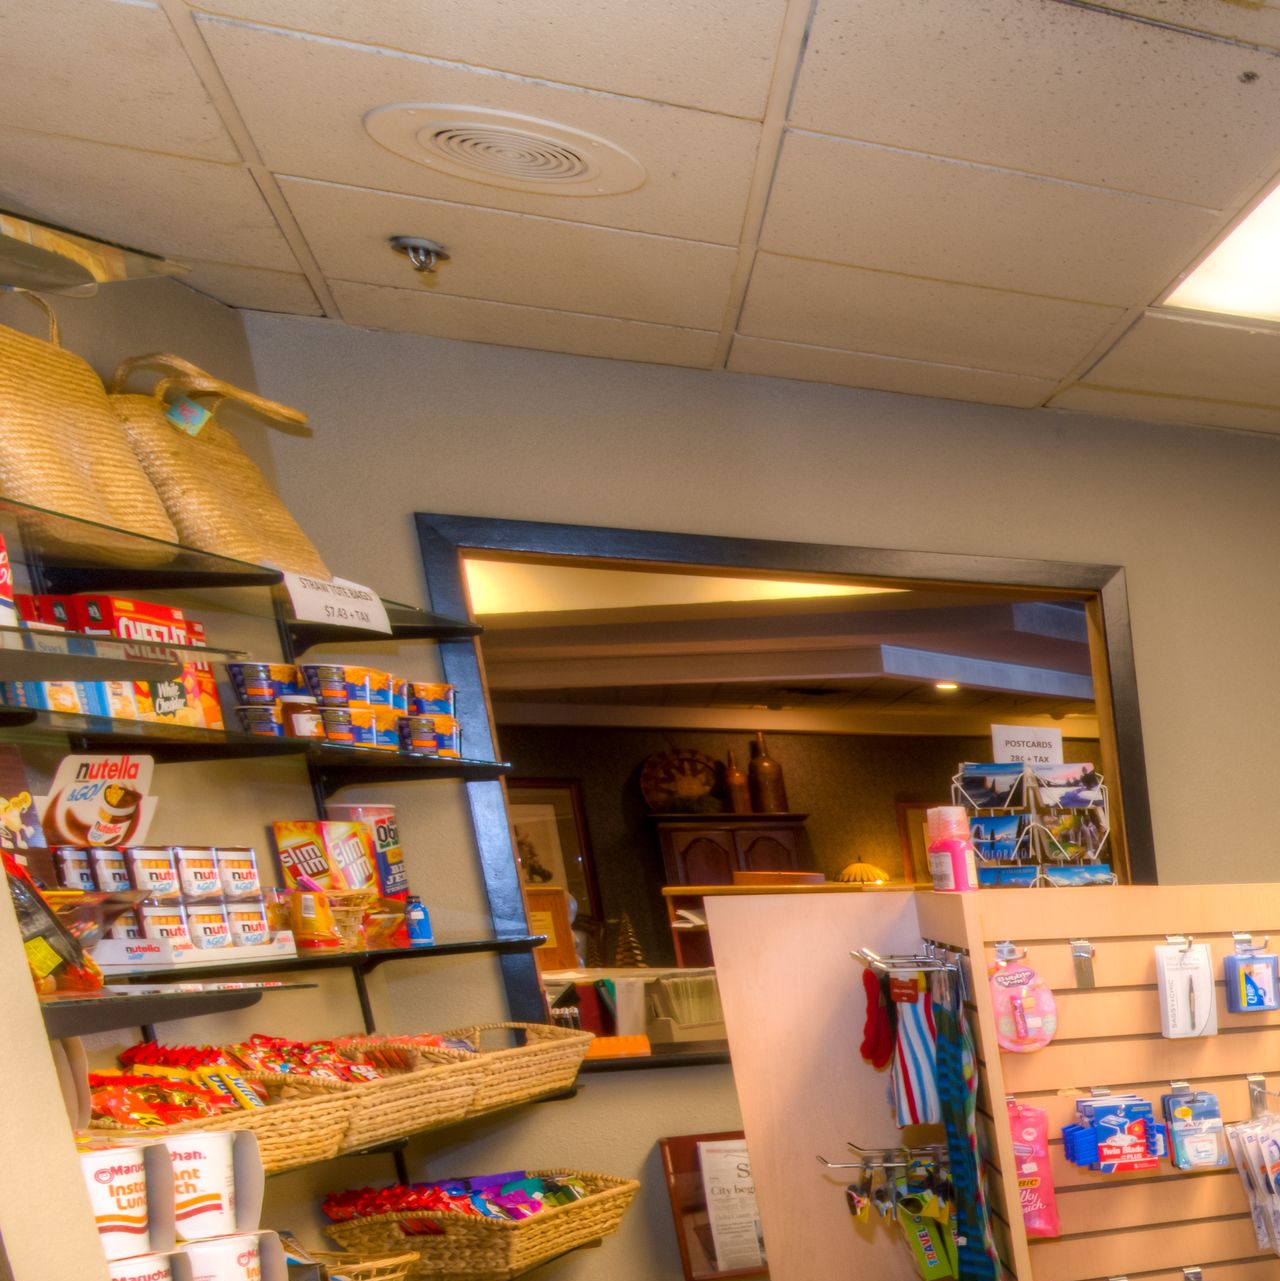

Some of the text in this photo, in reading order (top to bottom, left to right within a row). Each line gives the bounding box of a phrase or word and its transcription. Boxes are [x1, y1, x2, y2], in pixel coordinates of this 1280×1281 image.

[300, 576, 328, 593] STRAW
[331, 580, 350, 595] TOTE
[324, 605, 348, 619] $7.43
[356, 611, 370, 623] TAX
[1005, 740, 1052, 749] POSTCARDS
[75, 755, 139, 781] nutella
[1102, 1146, 1144, 1155] Twin Blade
[111, 1162, 145, 1177] Maruc
[711, 1185, 755, 1196] City beg
[117, 1196, 147, 1211] Lun
